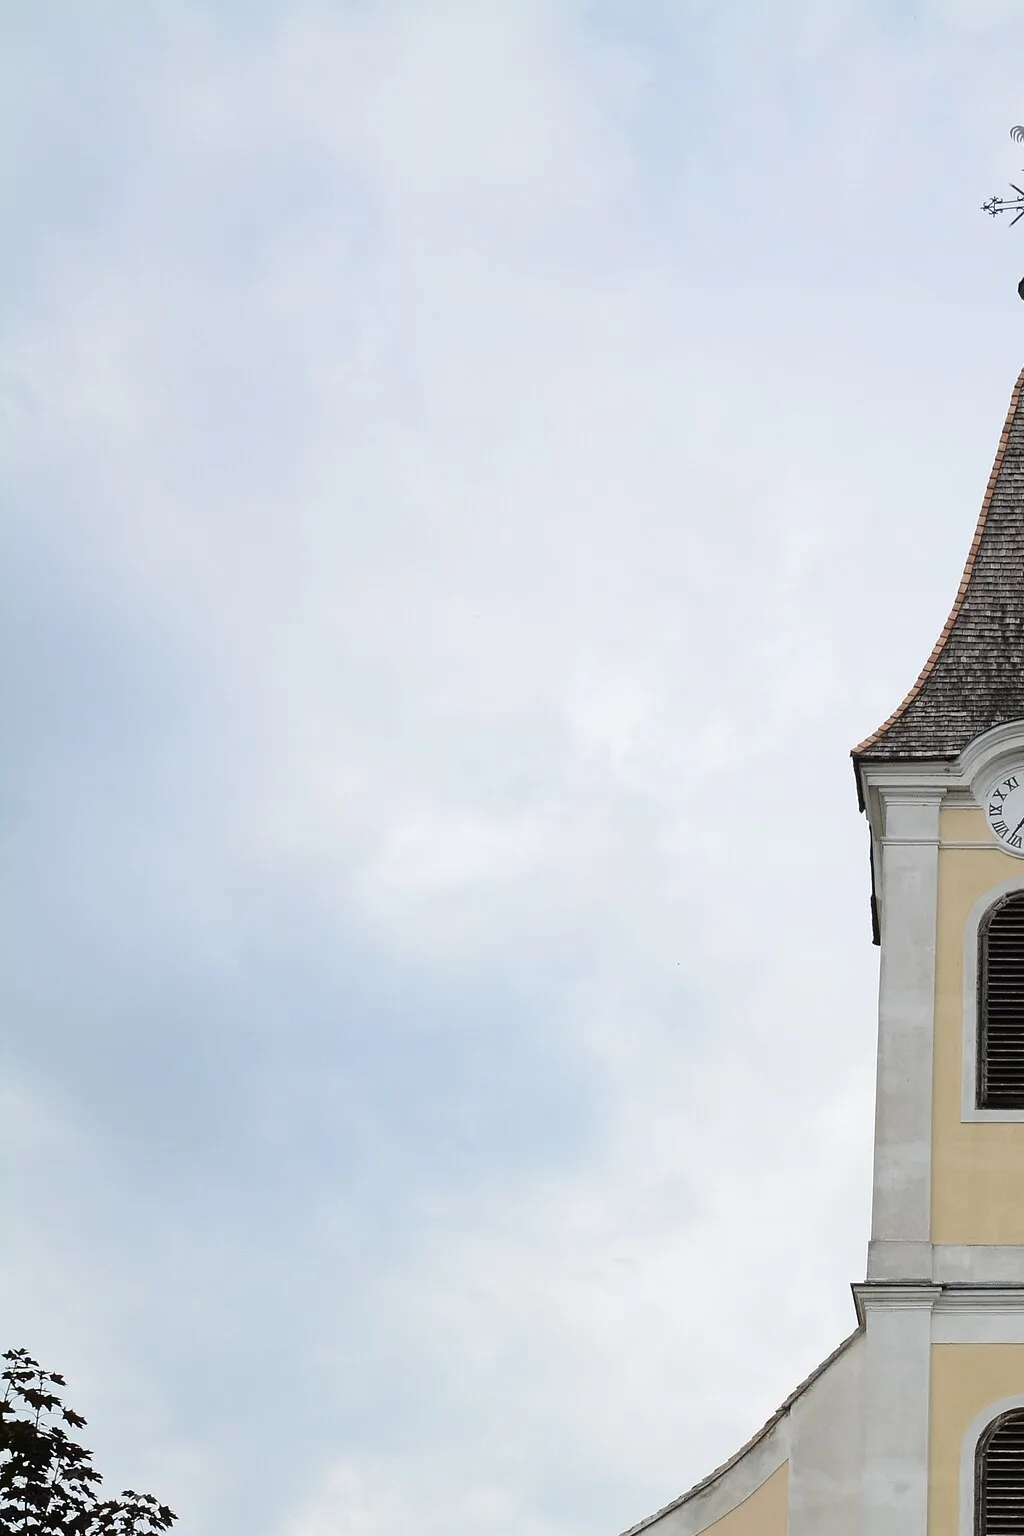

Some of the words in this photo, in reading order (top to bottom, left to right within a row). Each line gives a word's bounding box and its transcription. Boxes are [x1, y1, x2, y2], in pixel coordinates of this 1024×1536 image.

[1002, 776, 1020, 792] XI
[992, 788, 1008, 801] X
[989, 803, 1002, 816] IX
[992, 821, 1010, 838] VIII
